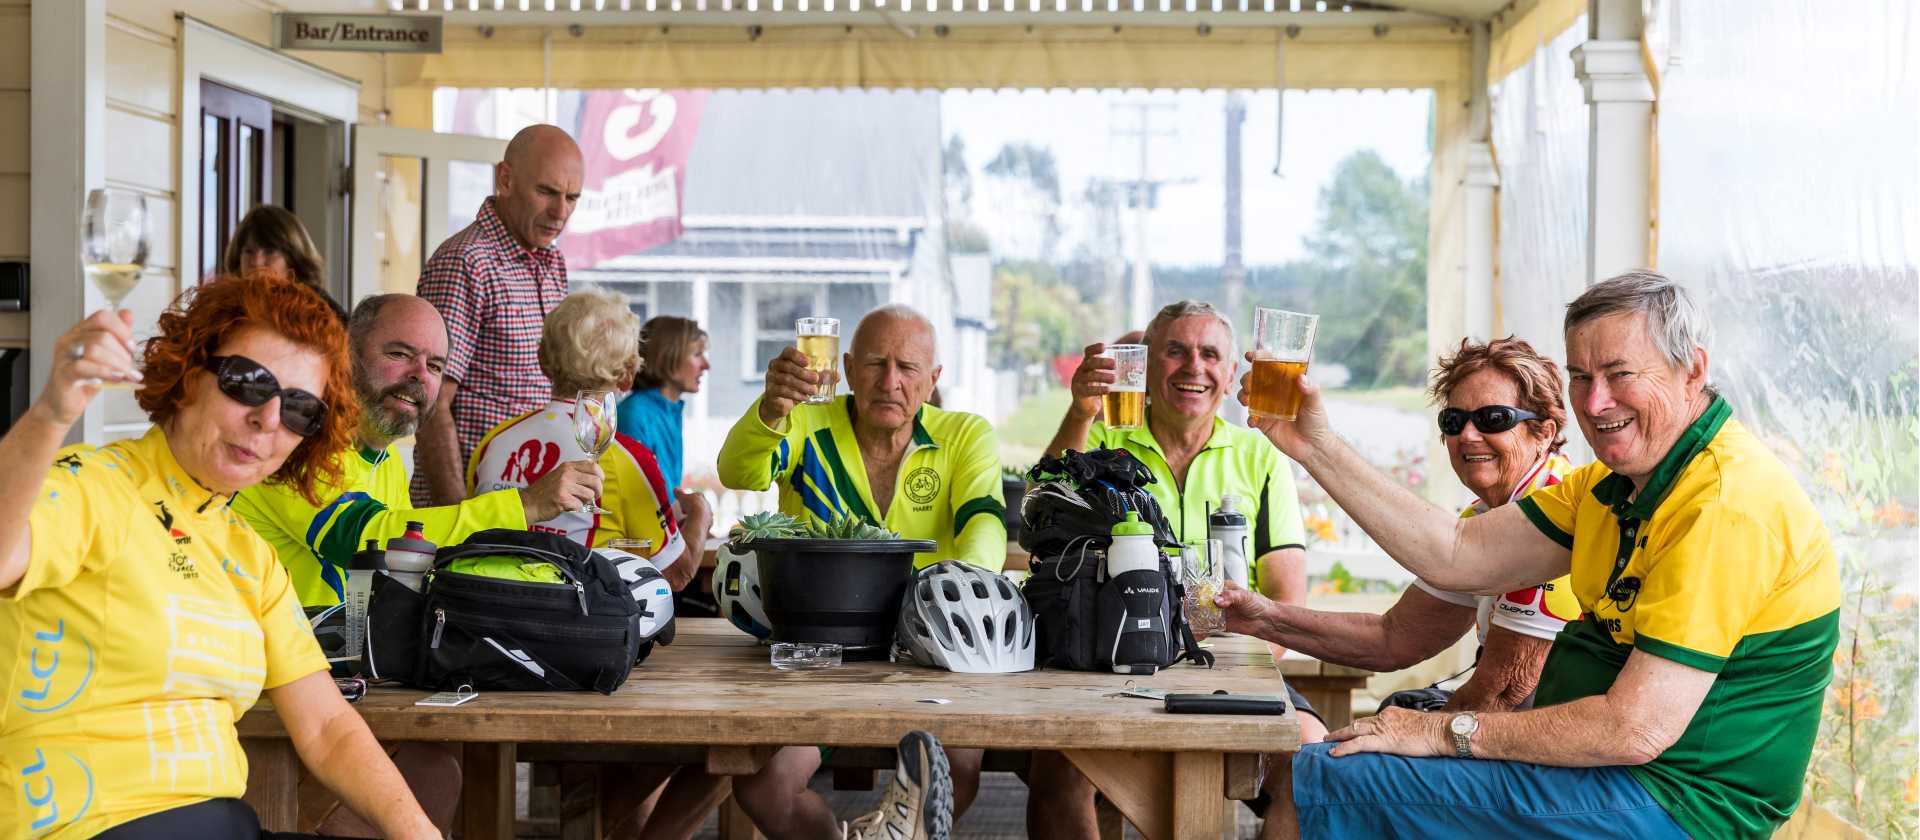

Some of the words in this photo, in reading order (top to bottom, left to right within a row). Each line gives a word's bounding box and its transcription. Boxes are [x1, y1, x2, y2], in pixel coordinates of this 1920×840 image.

[295, 21, 430, 43] Bar/Entrance
[20, 618, 64, 700] LCL
[21, 747, 58, 830] LCL
